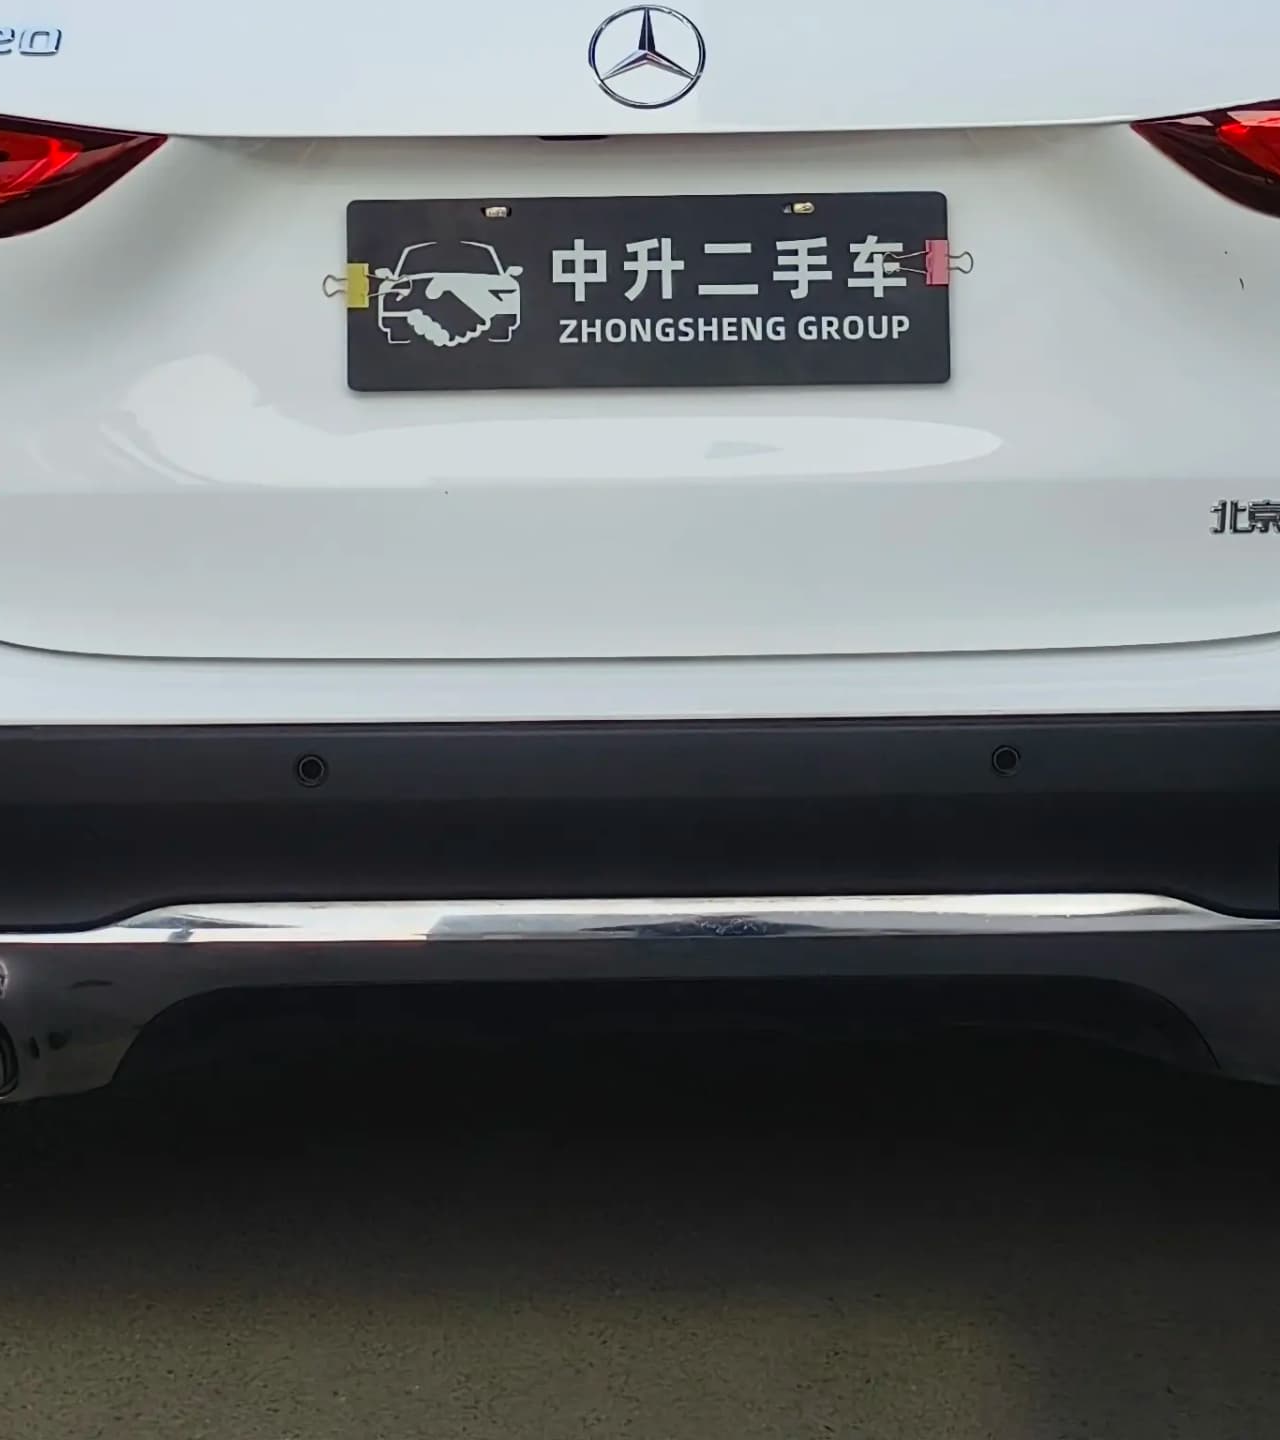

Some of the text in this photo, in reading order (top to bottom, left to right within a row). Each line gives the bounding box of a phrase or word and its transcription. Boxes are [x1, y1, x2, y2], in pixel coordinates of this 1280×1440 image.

[552, 235, 907, 302] 中升二手车
[558, 315, 910, 343] ZHONGSHENG GROUP
